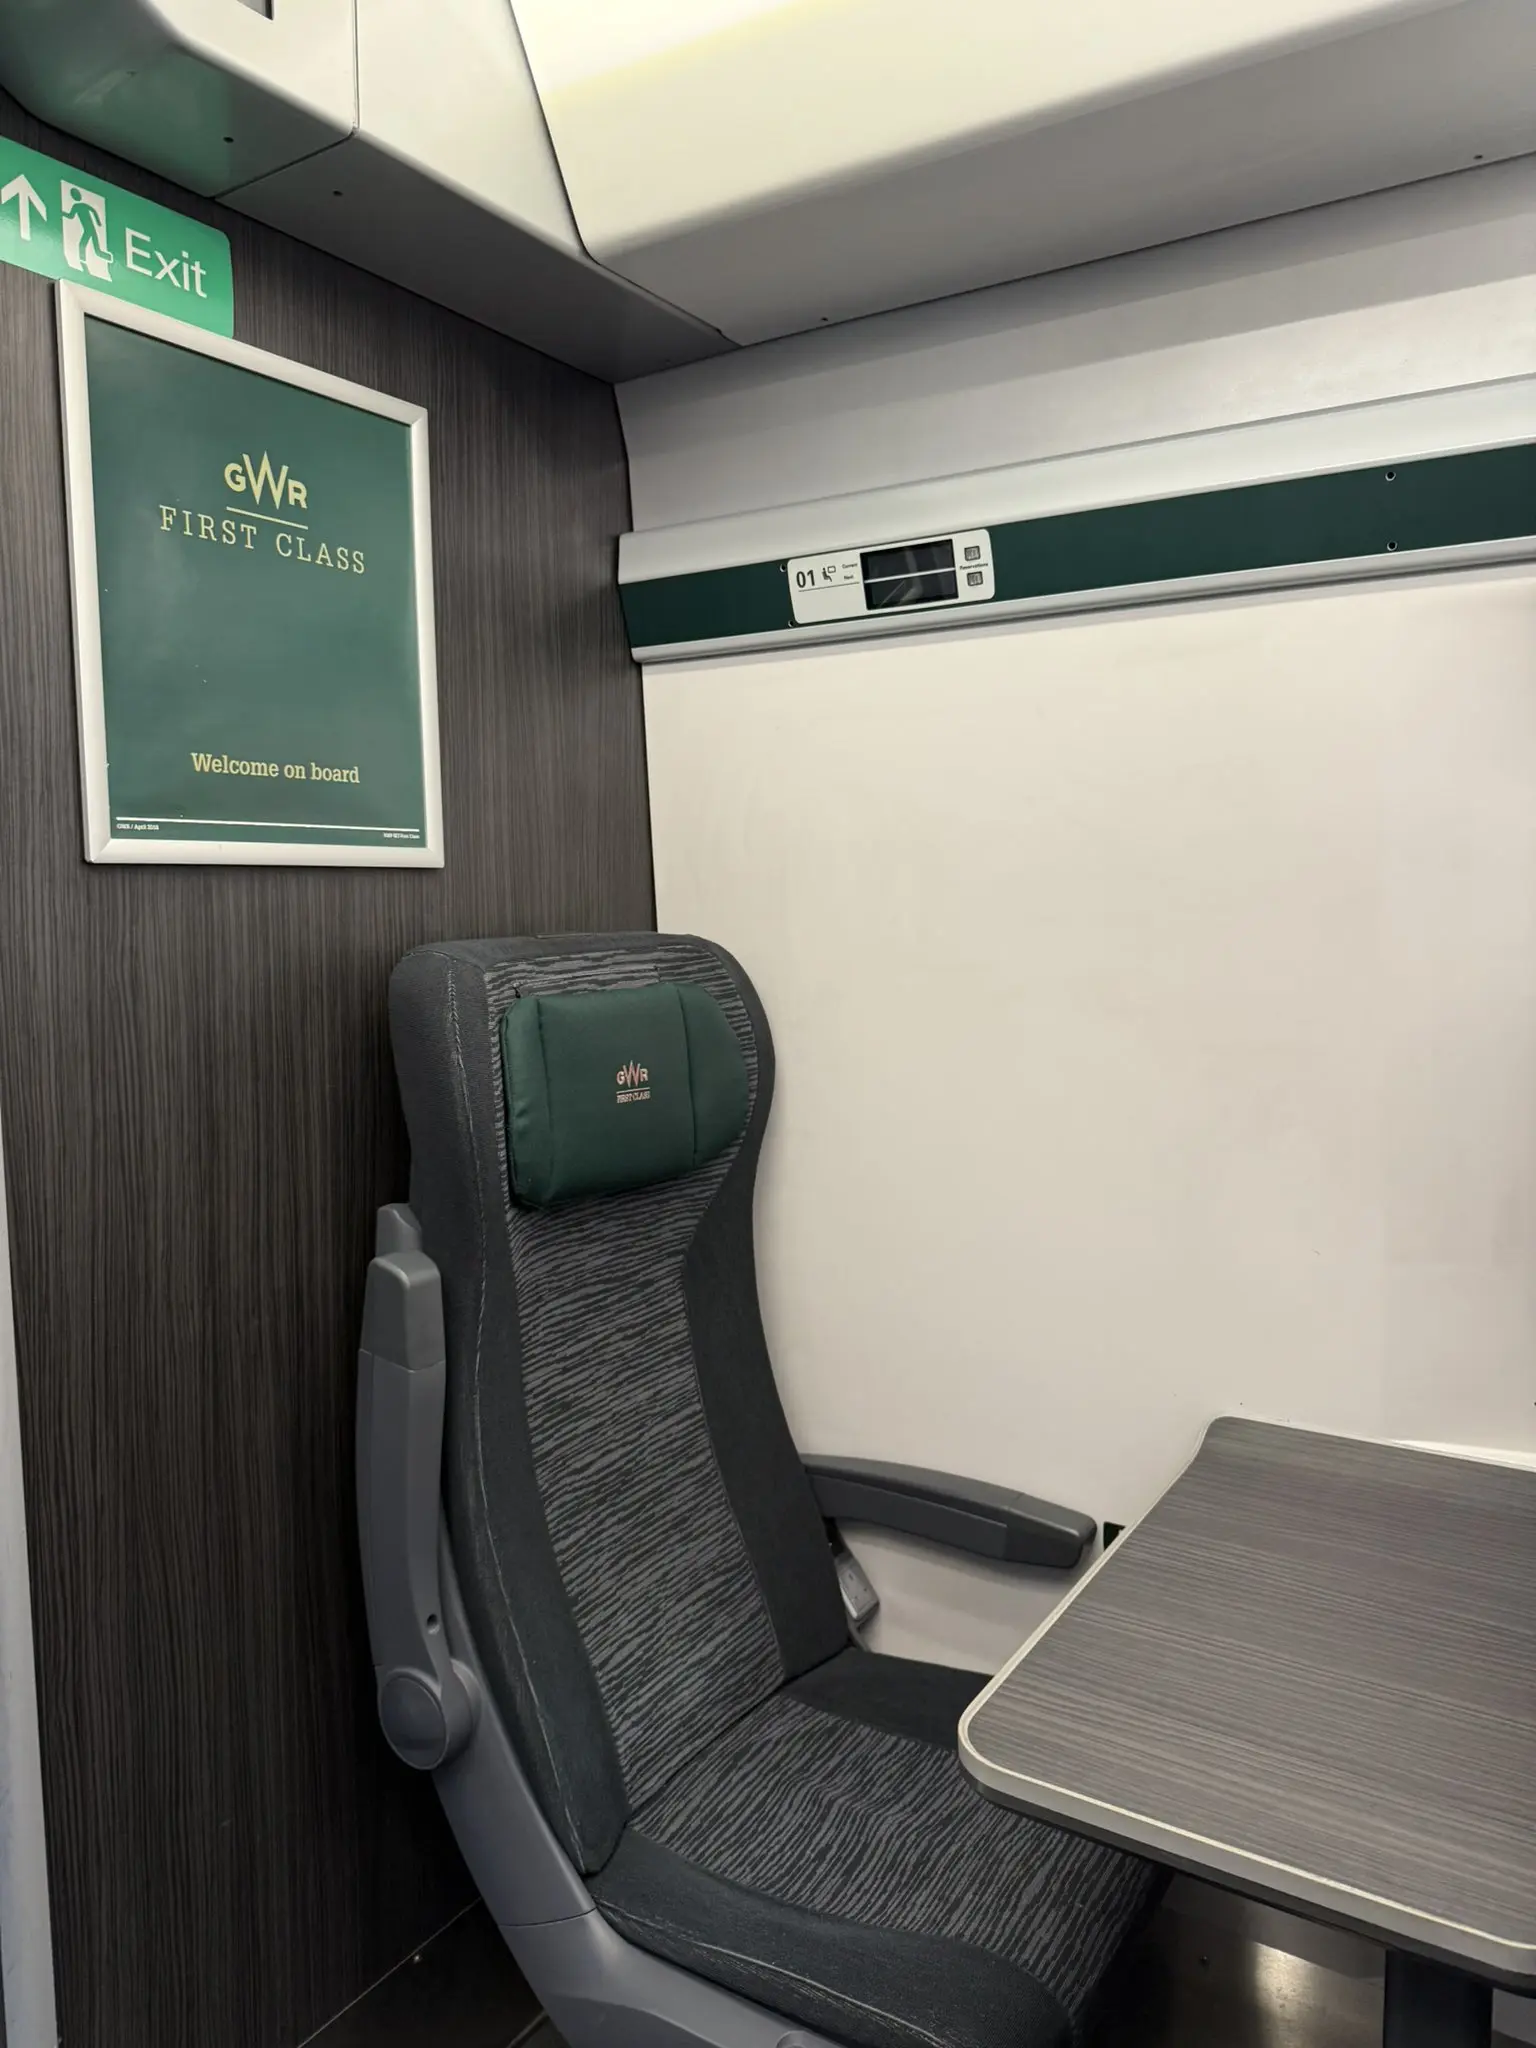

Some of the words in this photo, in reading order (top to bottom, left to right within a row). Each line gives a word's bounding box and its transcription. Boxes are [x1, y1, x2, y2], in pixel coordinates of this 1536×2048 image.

[124, 227, 207, 298] Exit
[224, 450, 308, 510] GWR
[159, 504, 257, 550] FIRST
[276, 532, 365, 574] CLASS
[796, 569, 815, 588] 01
[190, 752, 280, 777] Welcome
[283, 764, 306, 780] on
[310, 762, 360, 784] board
[616, 1060, 649, 1088] GWR
[616, 1093, 632, 1104] FIRST
